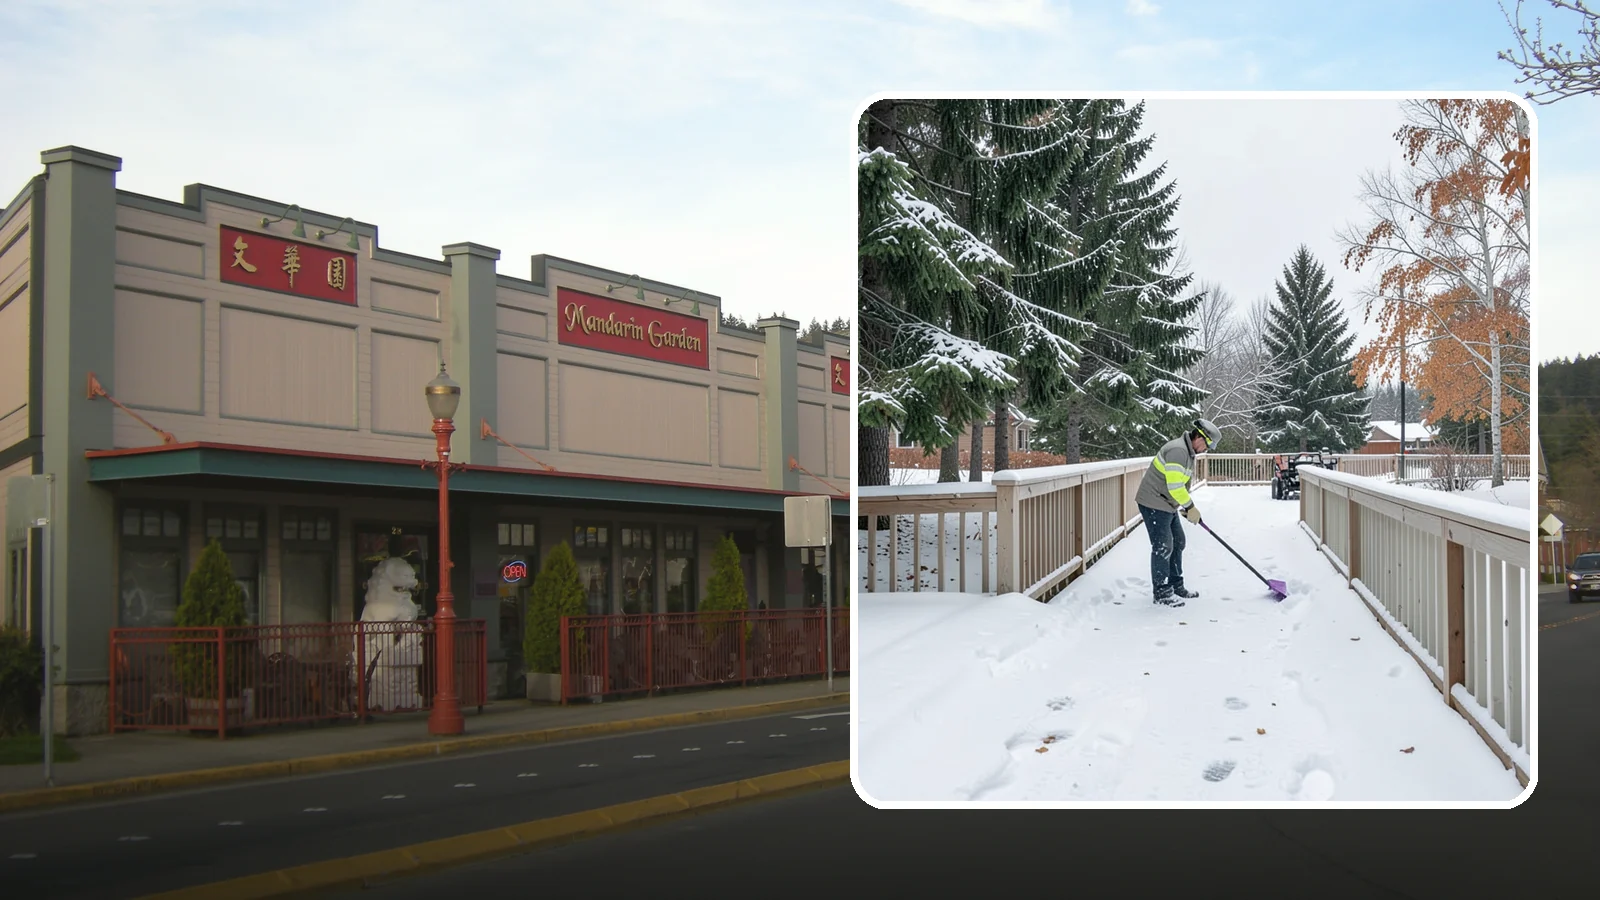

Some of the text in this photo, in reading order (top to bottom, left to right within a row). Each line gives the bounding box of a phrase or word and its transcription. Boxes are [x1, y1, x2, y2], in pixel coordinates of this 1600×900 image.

[231, 235, 346, 291] 文華園
[564, 302, 701, 352] Mandarin Garden
[503, 565, 527, 578] OPEN
